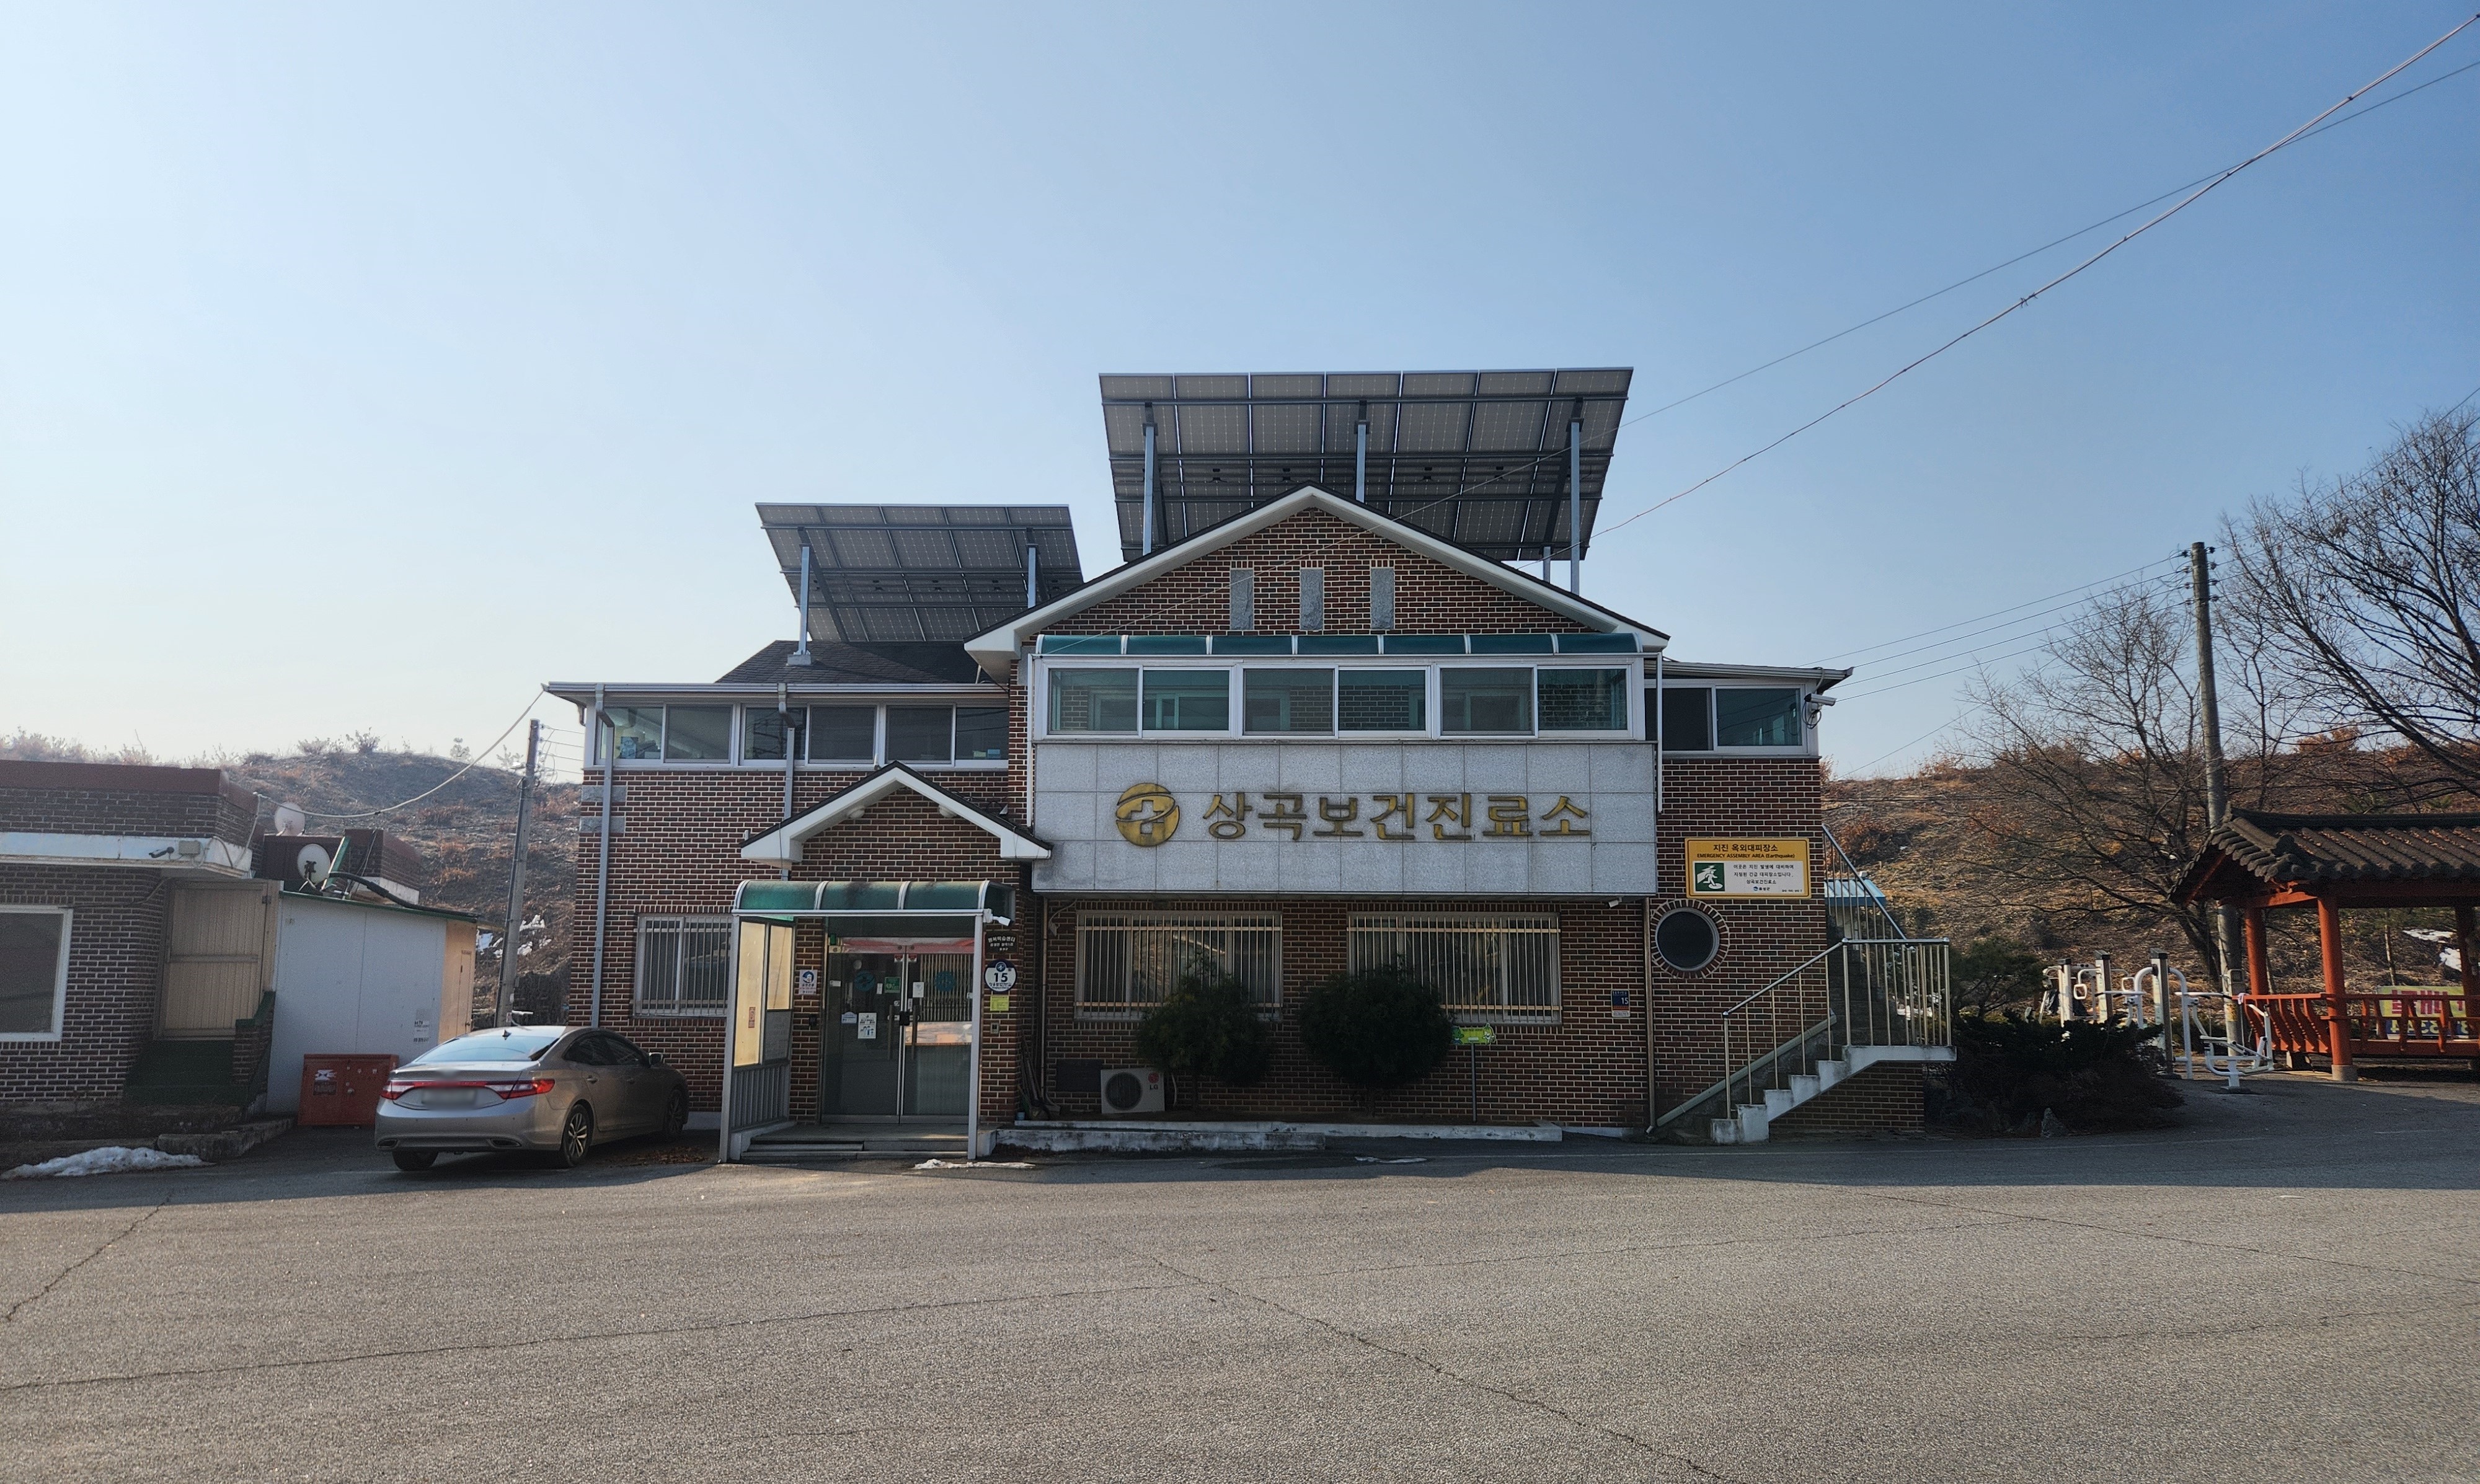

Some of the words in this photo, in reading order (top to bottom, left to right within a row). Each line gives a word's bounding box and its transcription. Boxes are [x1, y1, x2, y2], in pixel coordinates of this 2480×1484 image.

[1203, 792, 1590, 841] 상곡보건진료소
[1713, 844, 1729, 852] 지진
[1731, 844, 1778, 852] 옥외대피장소
[994, 972, 1008, 983] 15
